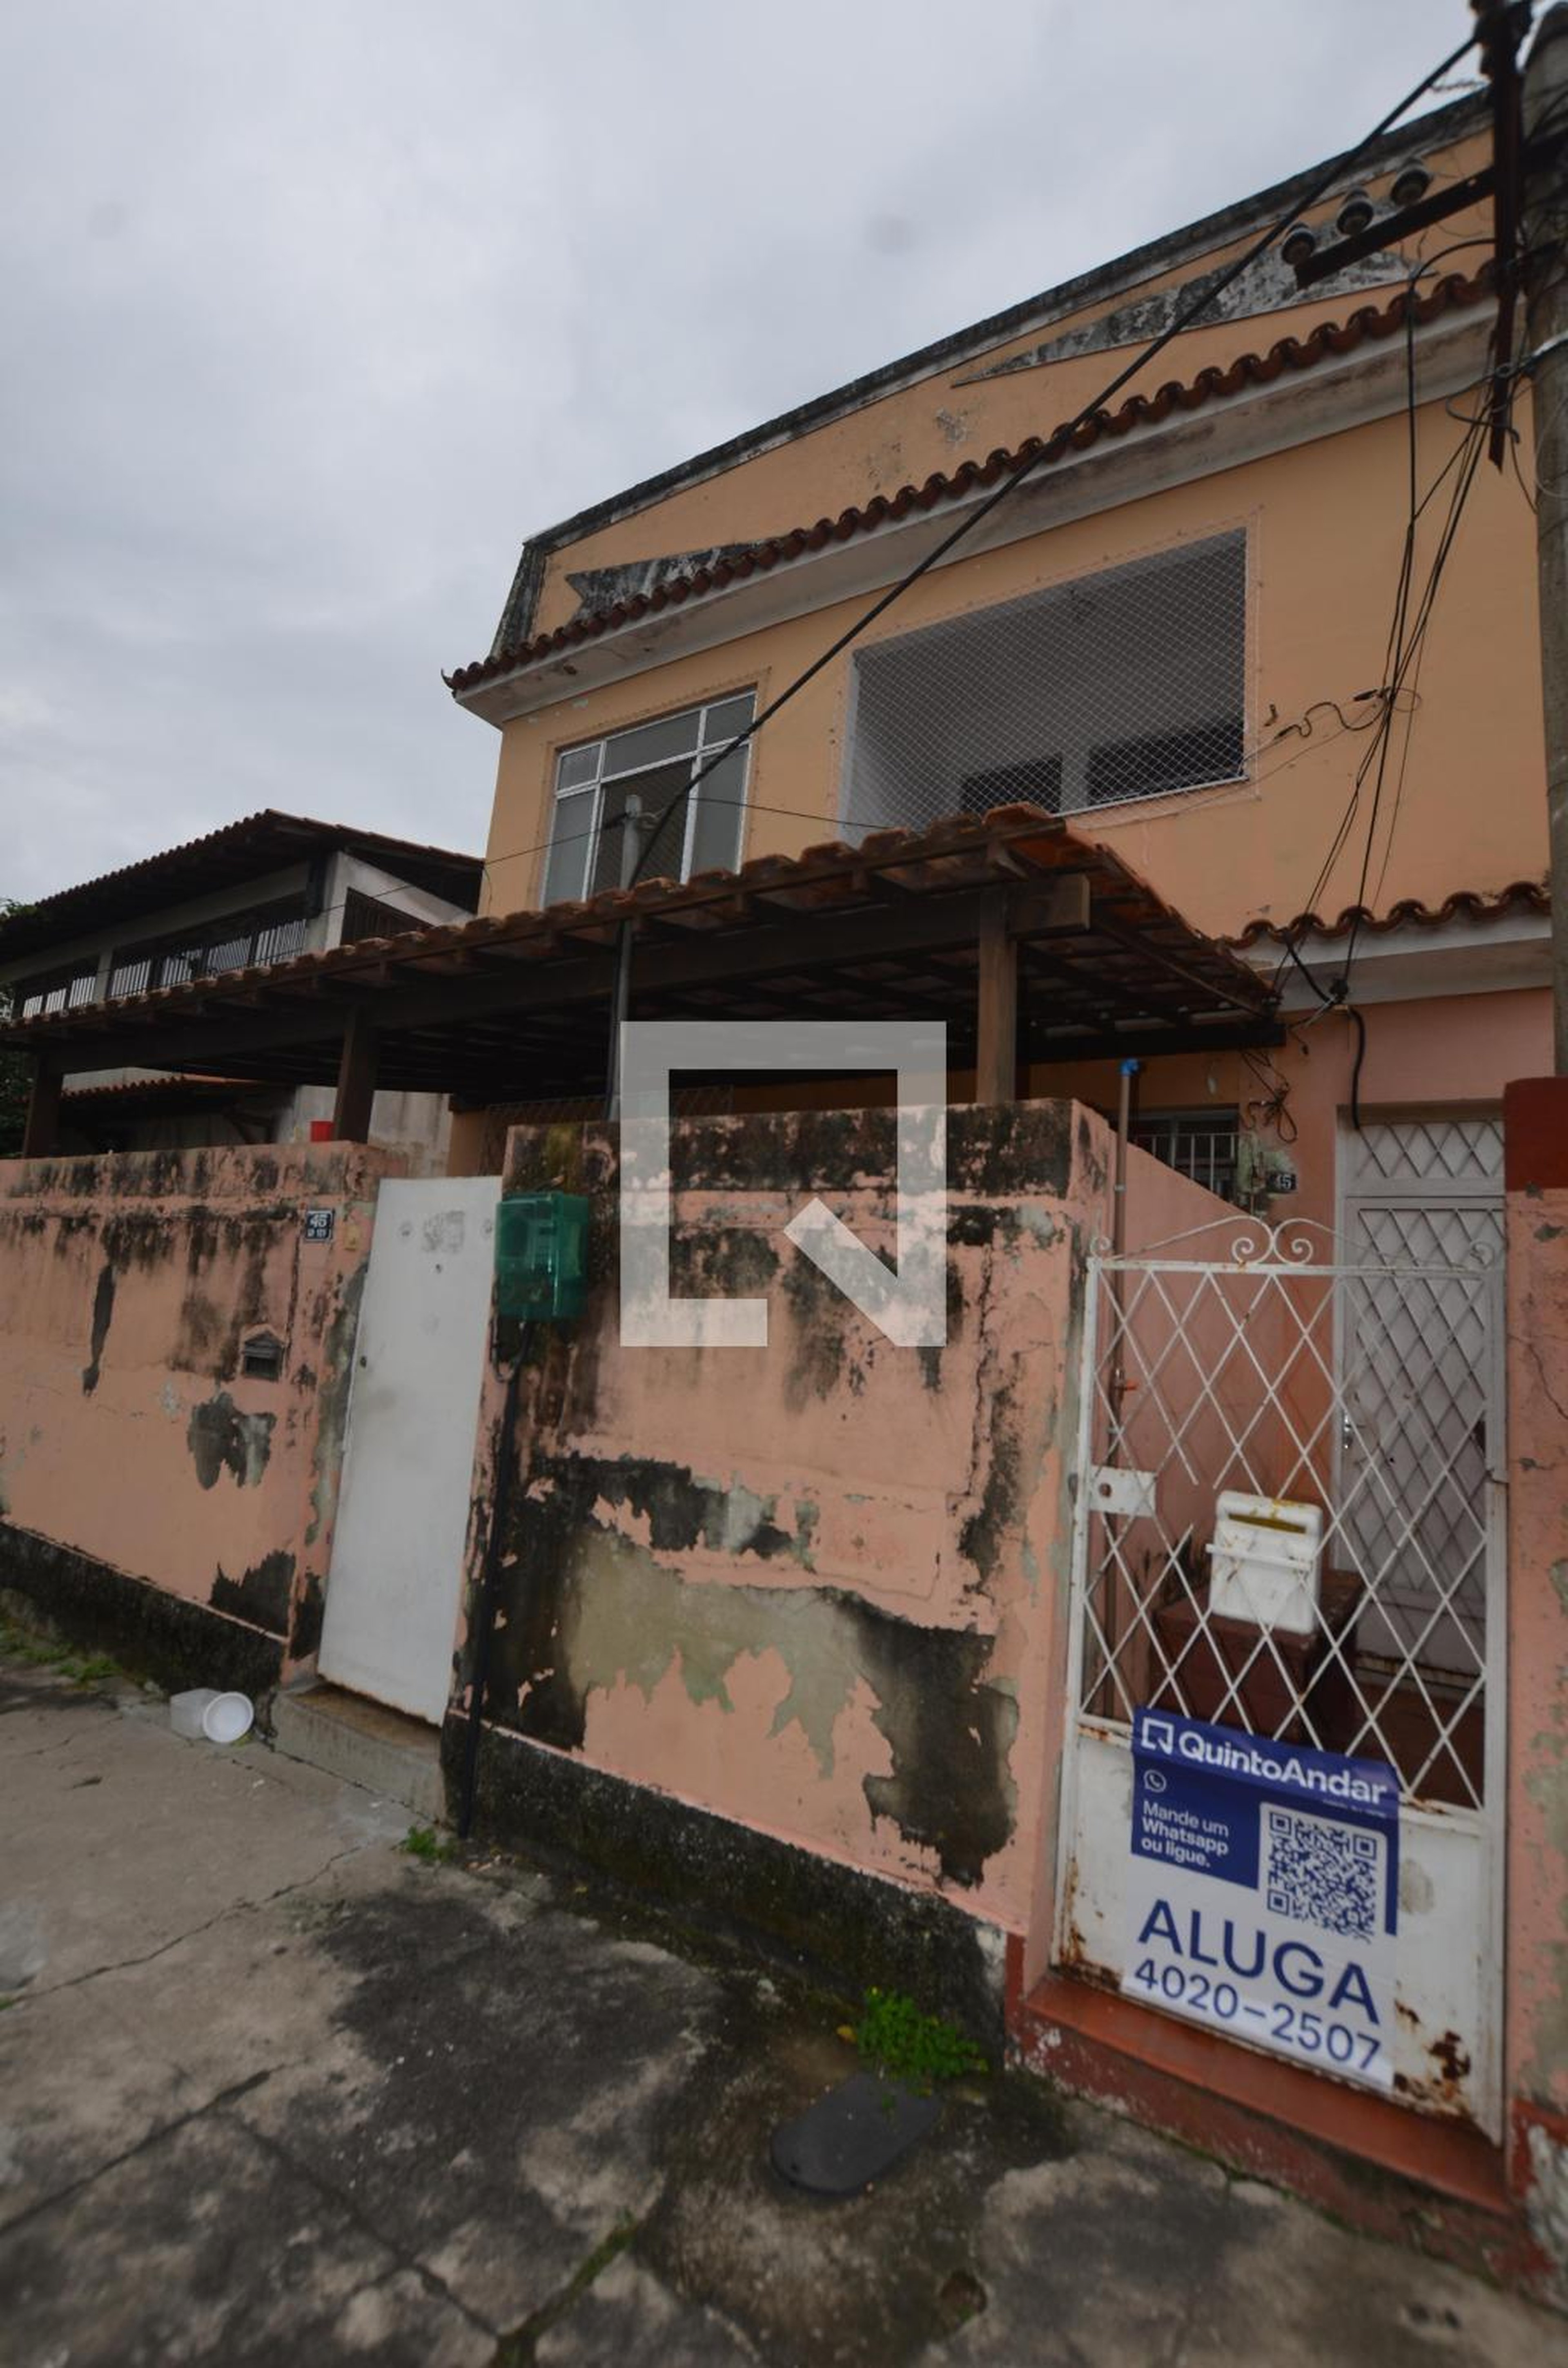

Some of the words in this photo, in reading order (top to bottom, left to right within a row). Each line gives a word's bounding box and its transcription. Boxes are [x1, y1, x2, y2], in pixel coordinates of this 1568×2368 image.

[310, 1214, 327, 1227] 45
[1178, 1731, 1387, 1804] QuintoAndar
[1142, 1816, 1229, 1856] Whatsapp
[1143, 1800, 1199, 1829] Mande
[1202, 1818, 1229, 1837] um
[1141, 1838, 1163, 1853] ou
[1166, 1841, 1211, 1868] ligue.
[1138, 1900, 1380, 2025] ALUGA
[1135, 1959, 1381, 2070] 4020-2507
